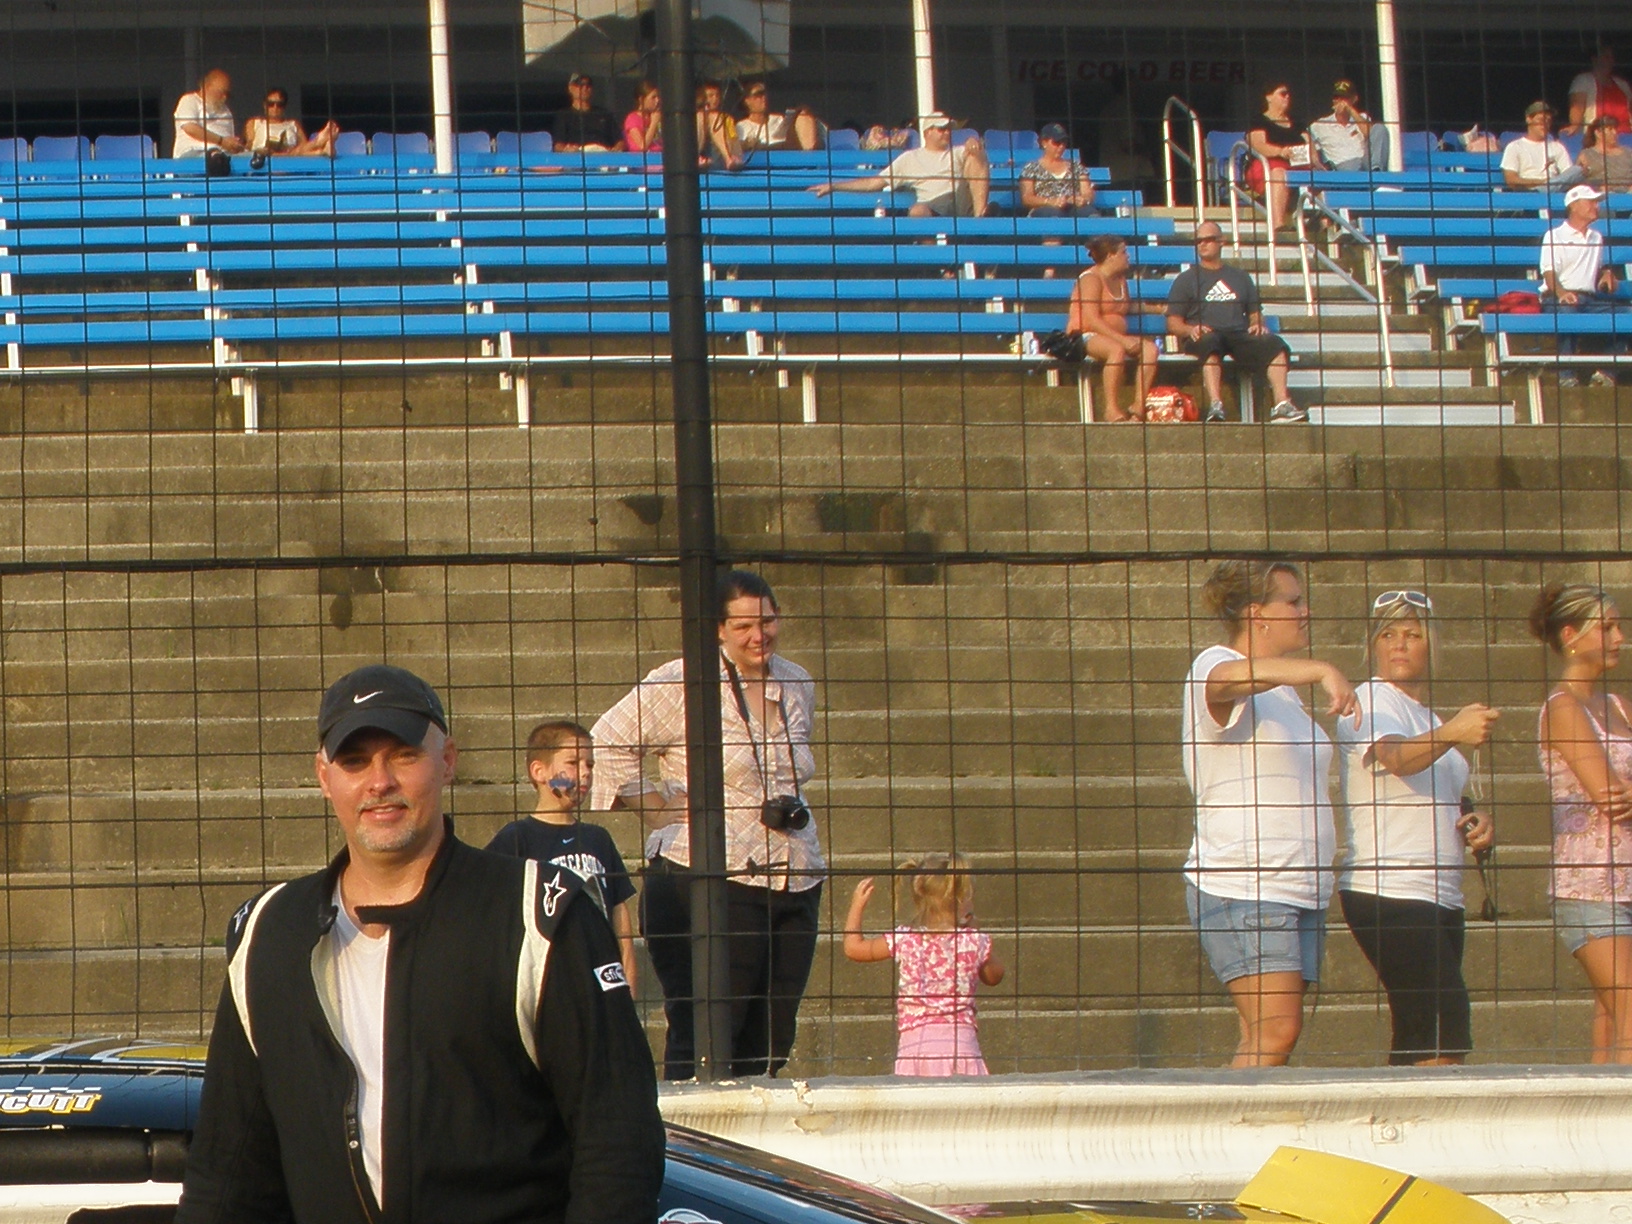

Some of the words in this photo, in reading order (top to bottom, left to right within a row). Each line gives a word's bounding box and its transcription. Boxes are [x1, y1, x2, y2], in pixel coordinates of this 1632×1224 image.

[1017, 60, 1067, 82] ICE
[1077, 60, 1159, 82] COD
[1167, 60, 1247, 83] BEER
[1205, 292, 1236, 302] adidas
